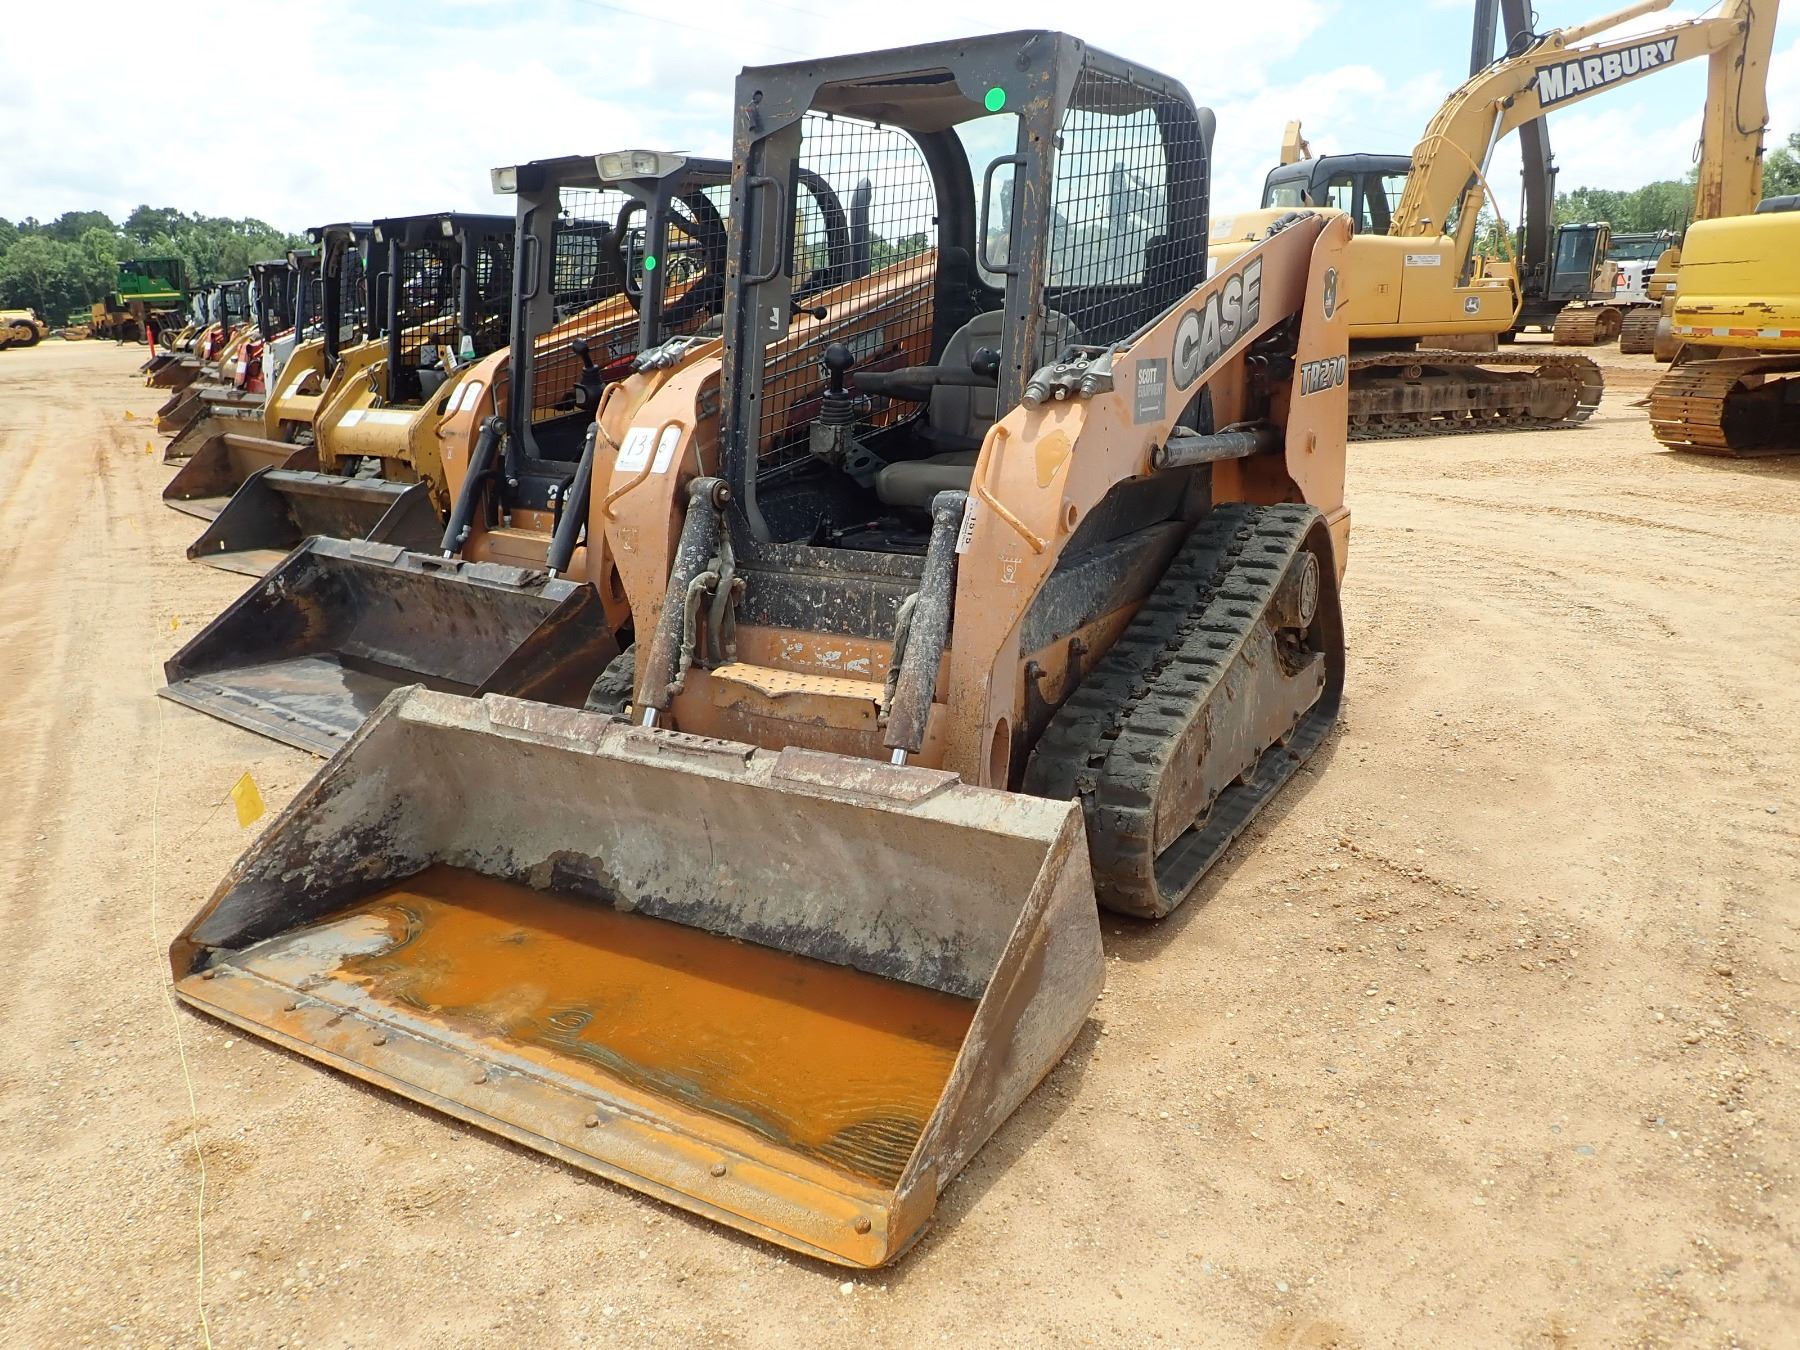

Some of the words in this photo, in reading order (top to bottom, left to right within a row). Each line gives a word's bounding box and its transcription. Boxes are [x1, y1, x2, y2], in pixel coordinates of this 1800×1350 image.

[1538, 39, 1675, 103] MARBURY
[1173, 255, 1262, 390] CASE
[1138, 368, 1158, 384] SCOTT
[1301, 355, 1346, 396] TR270
